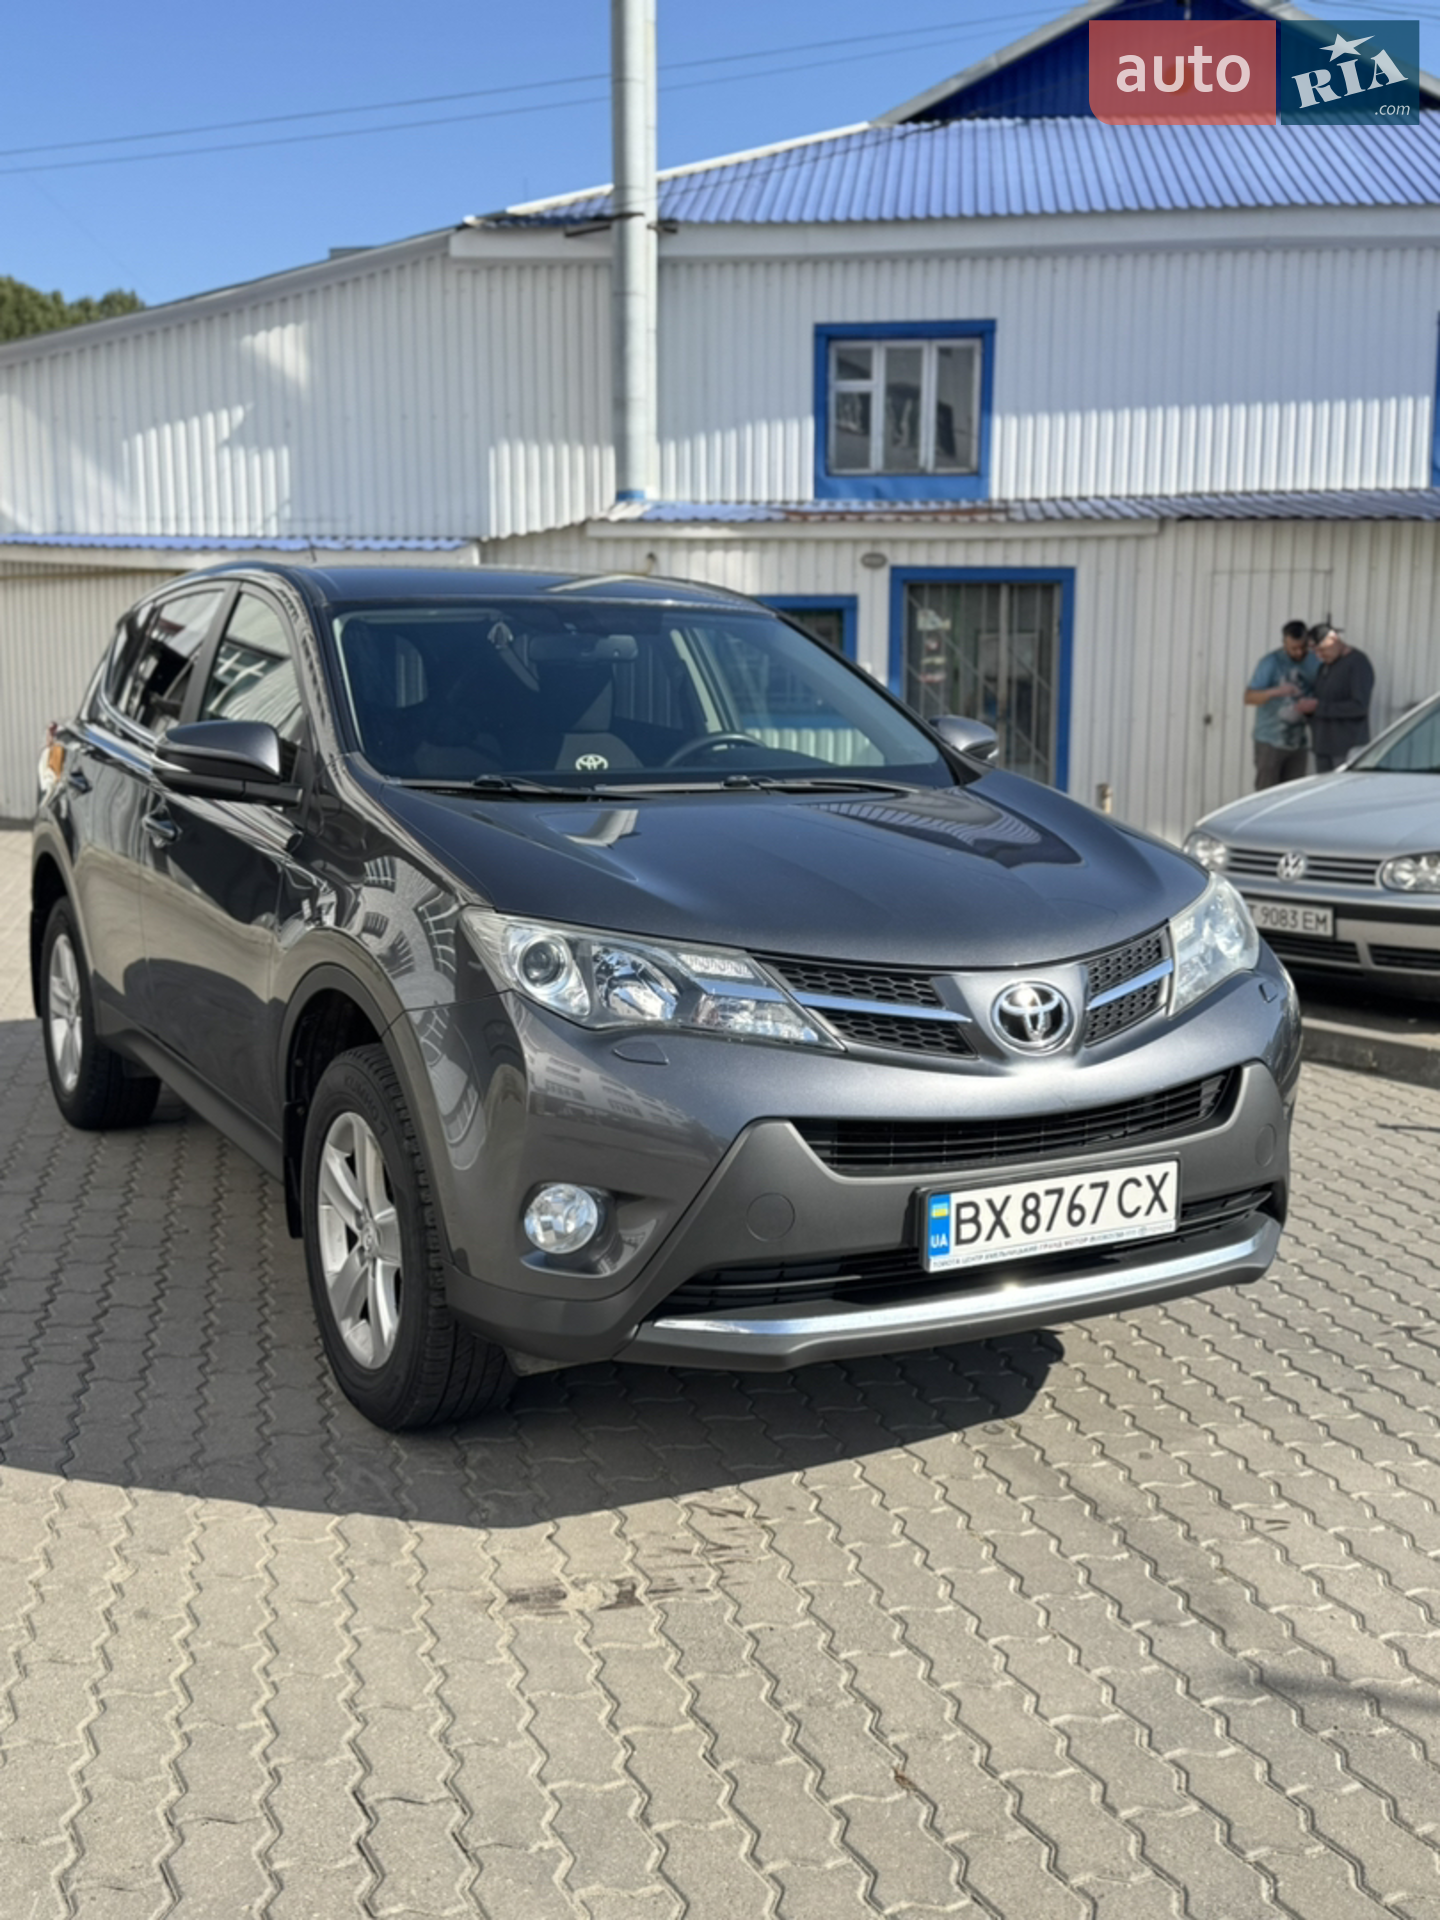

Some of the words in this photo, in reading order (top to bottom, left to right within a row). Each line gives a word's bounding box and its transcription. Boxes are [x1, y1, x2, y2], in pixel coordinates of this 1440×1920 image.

[1260, 906, 1299, 929] 9083
[1302, 911, 1329, 932] EM
[955, 1194, 1012, 1246] BX
[1020, 1180, 1110, 1235] 8767
[1117, 1171, 1170, 1219] CX
[930, 1234, 948, 1249] UA
